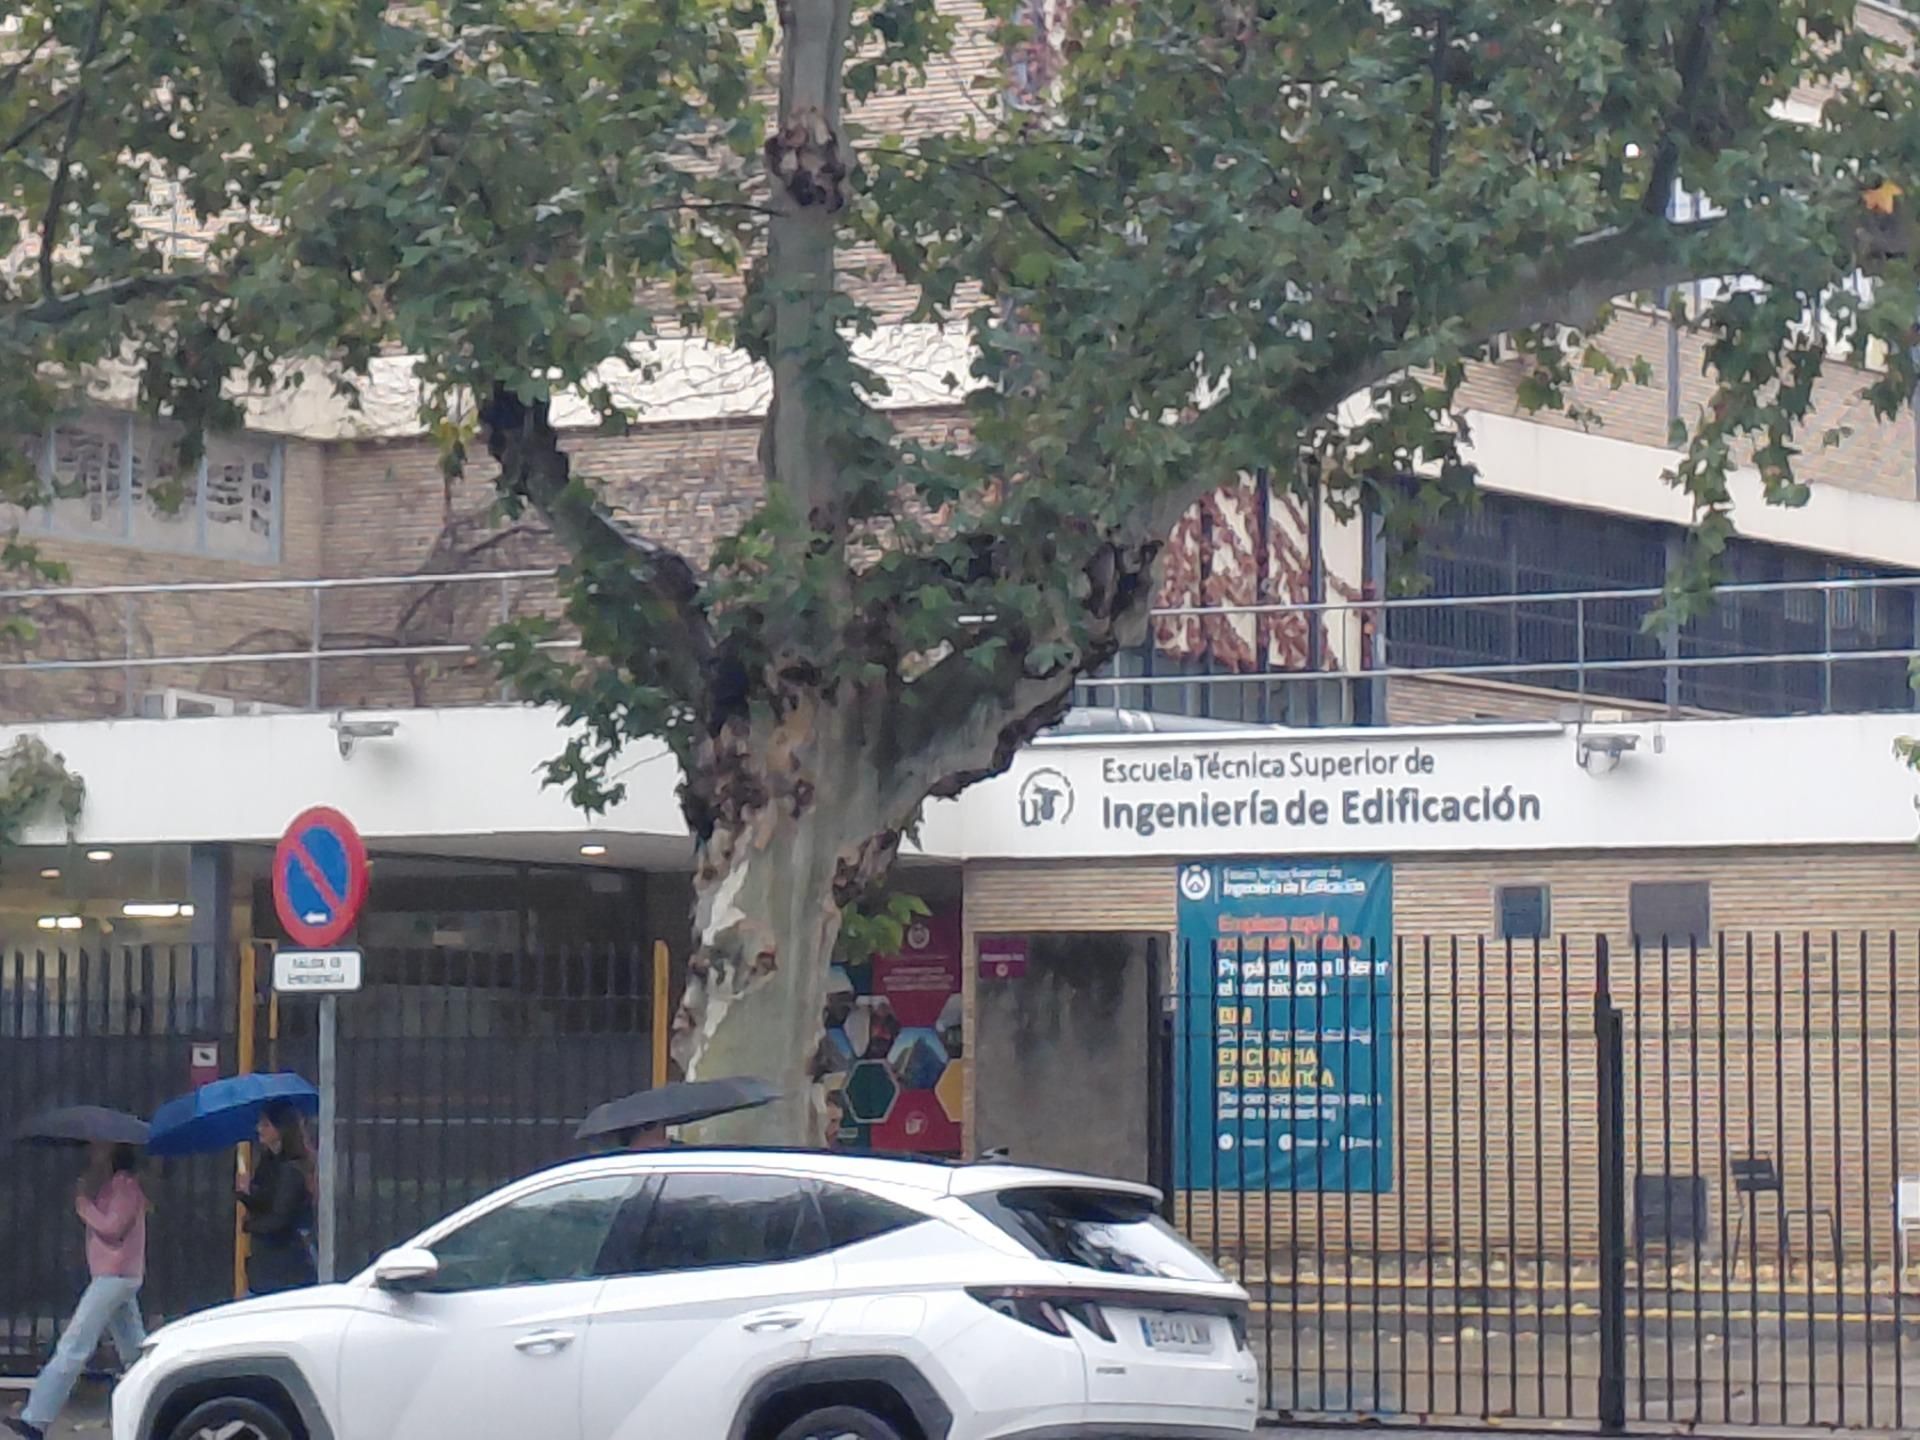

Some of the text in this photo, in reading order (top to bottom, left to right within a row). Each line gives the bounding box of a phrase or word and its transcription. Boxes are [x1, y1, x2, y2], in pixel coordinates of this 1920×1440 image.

[1102, 746, 1434, 783] Escuela Técnica Superior de
[1103, 785, 1540, 837] Ingeniería de Edificación
